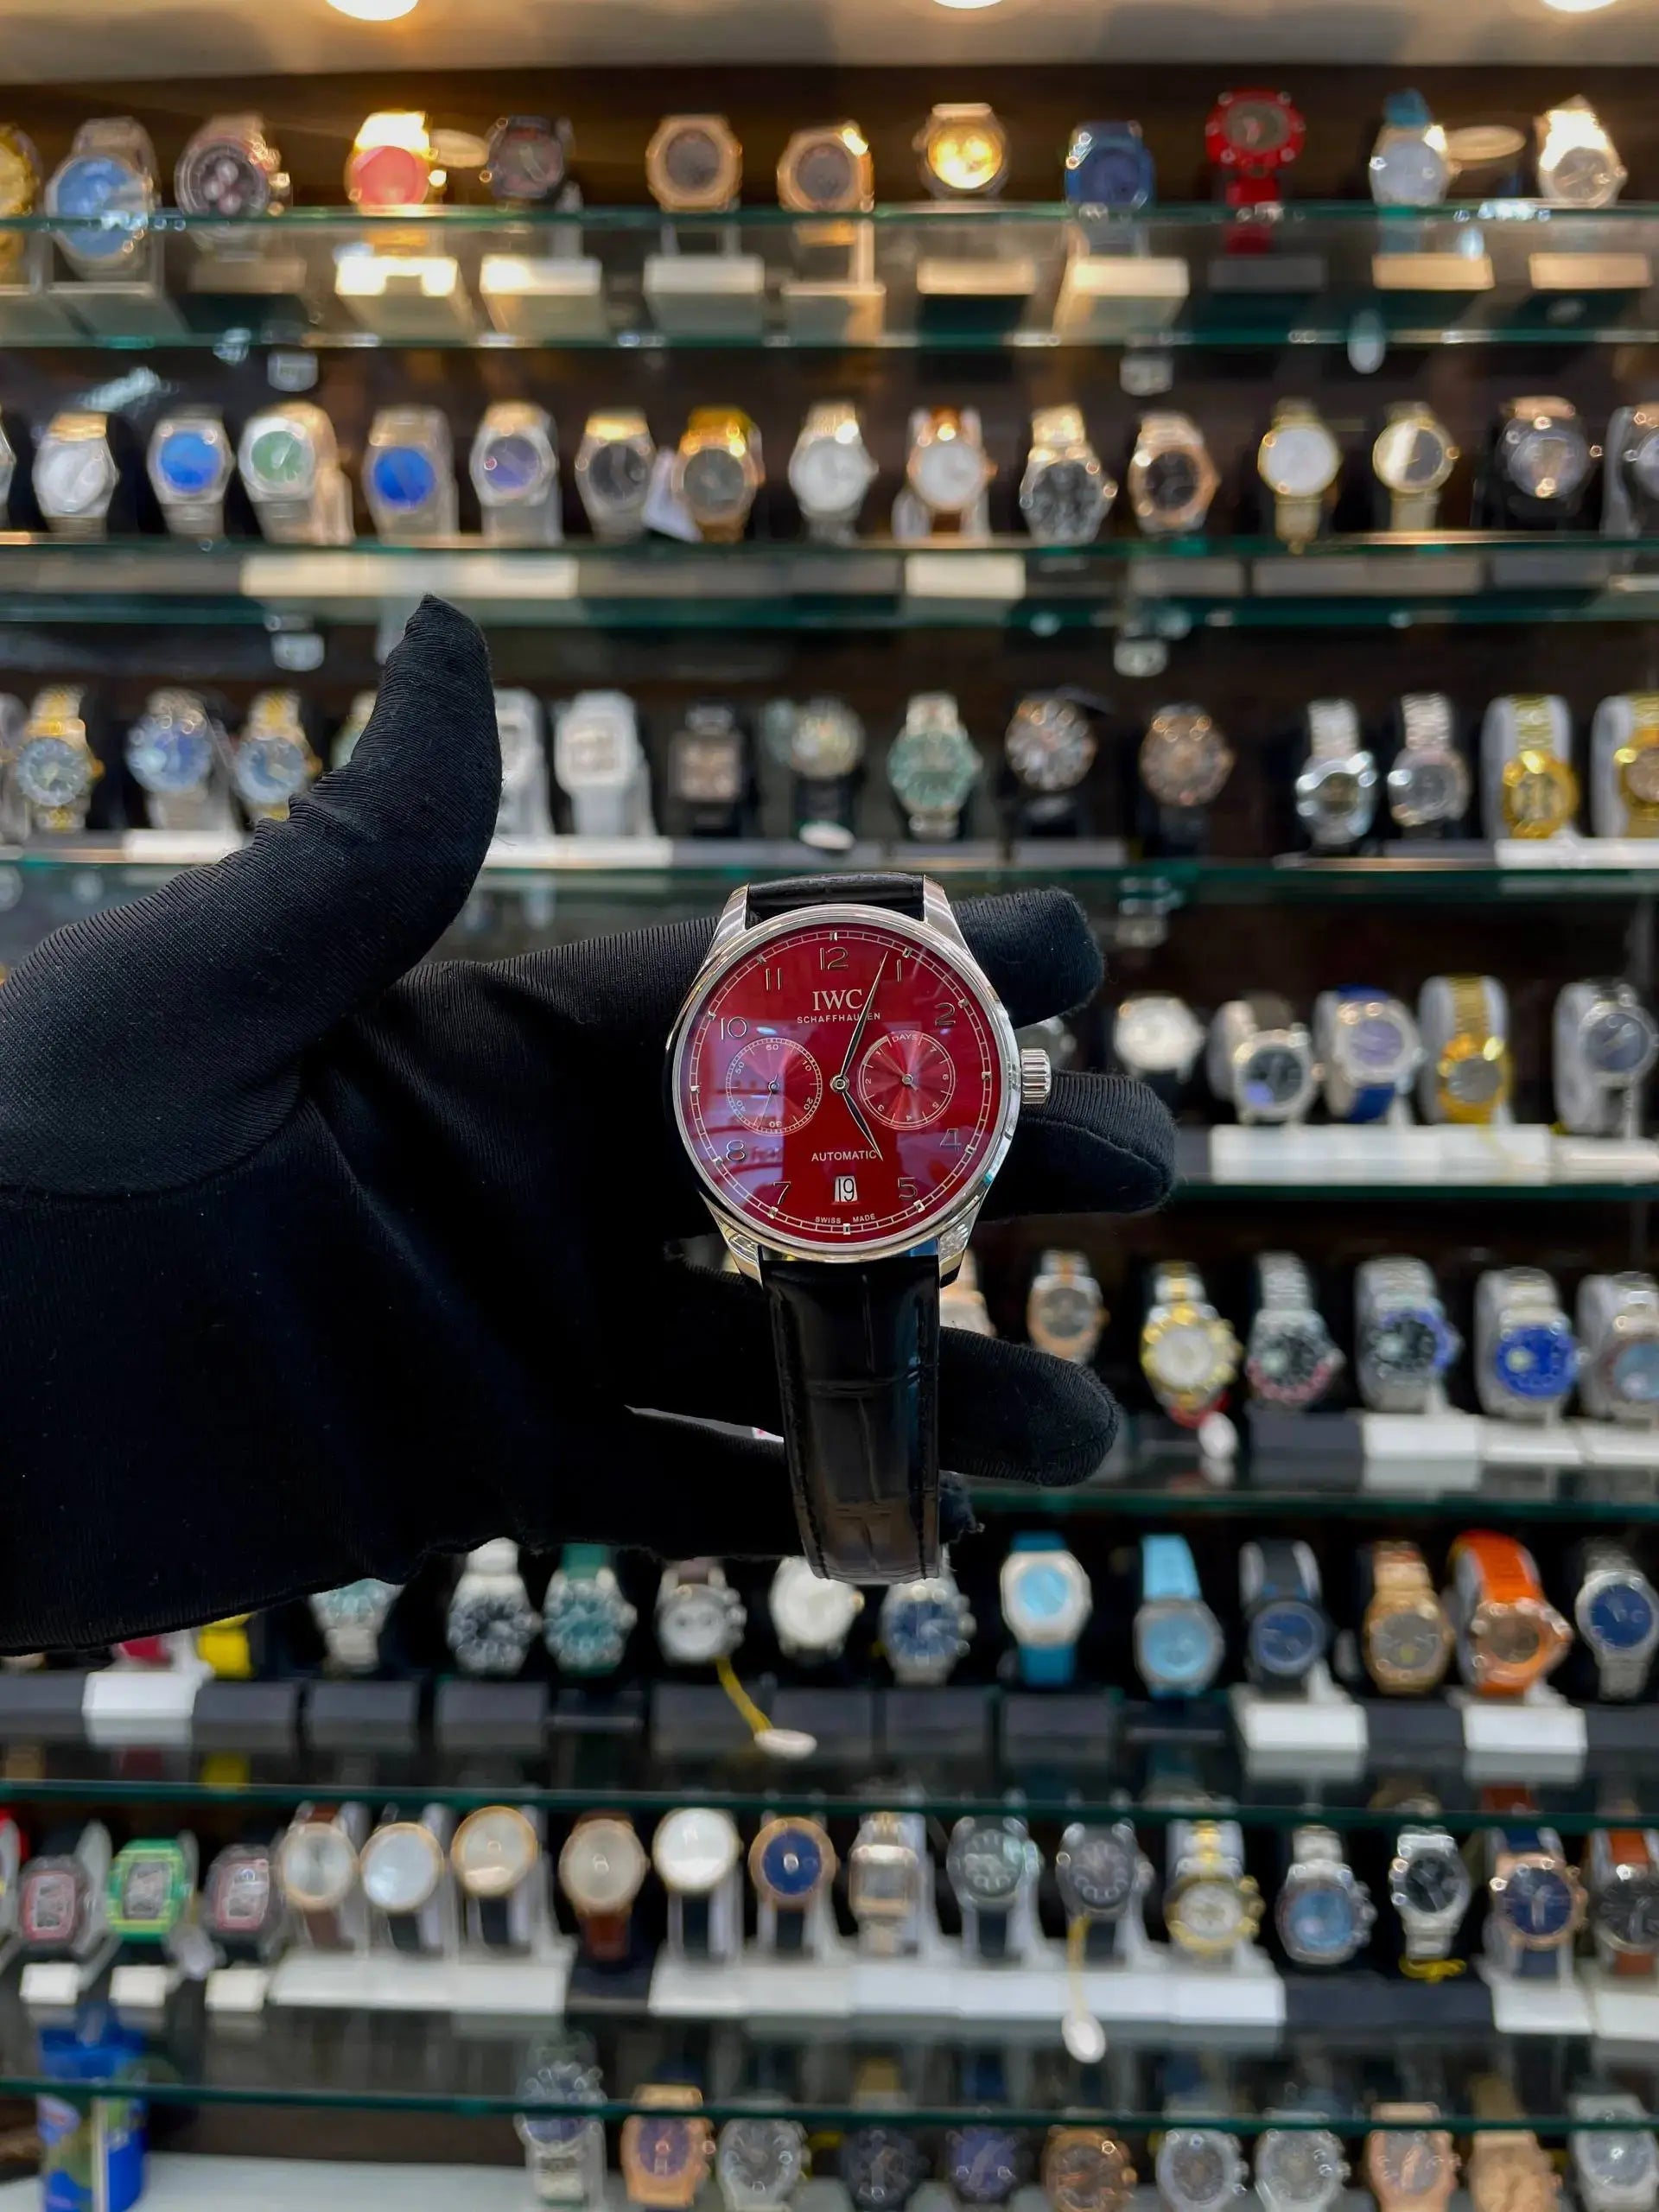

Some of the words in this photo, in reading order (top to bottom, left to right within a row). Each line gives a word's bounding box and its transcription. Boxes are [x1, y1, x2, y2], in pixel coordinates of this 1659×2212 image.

[819, 947, 849, 969] 12
[766, 967, 782, 991] 11
[896, 959, 902, 982] 1
[812, 988, 863, 1011] IWC
[797, 1012, 880, 1024] SCHAFFHAUEN
[934, 1002, 956, 1026] 2
[721, 1016, 747, 1040] 10
[892, 1033, 918, 1043] DAYS
[734, 1061, 745, 1075] 50
[802, 1059, 812, 1071] 10
[735, 1100, 747, 1113] 40
[804, 1096, 813, 1110] 20
[726, 1140, 746, 1162] 8
[940, 1128, 962, 1152] 4
[811, 1150, 877, 1161] AUTOMATIC
[772, 1181, 791, 1205] 7
[838, 1178, 855, 1202] 19
[897, 1177, 918, 1199] 5
[815, 1216, 842, 1224] SWISS
[852, 1213, 876, 1224] MADE
